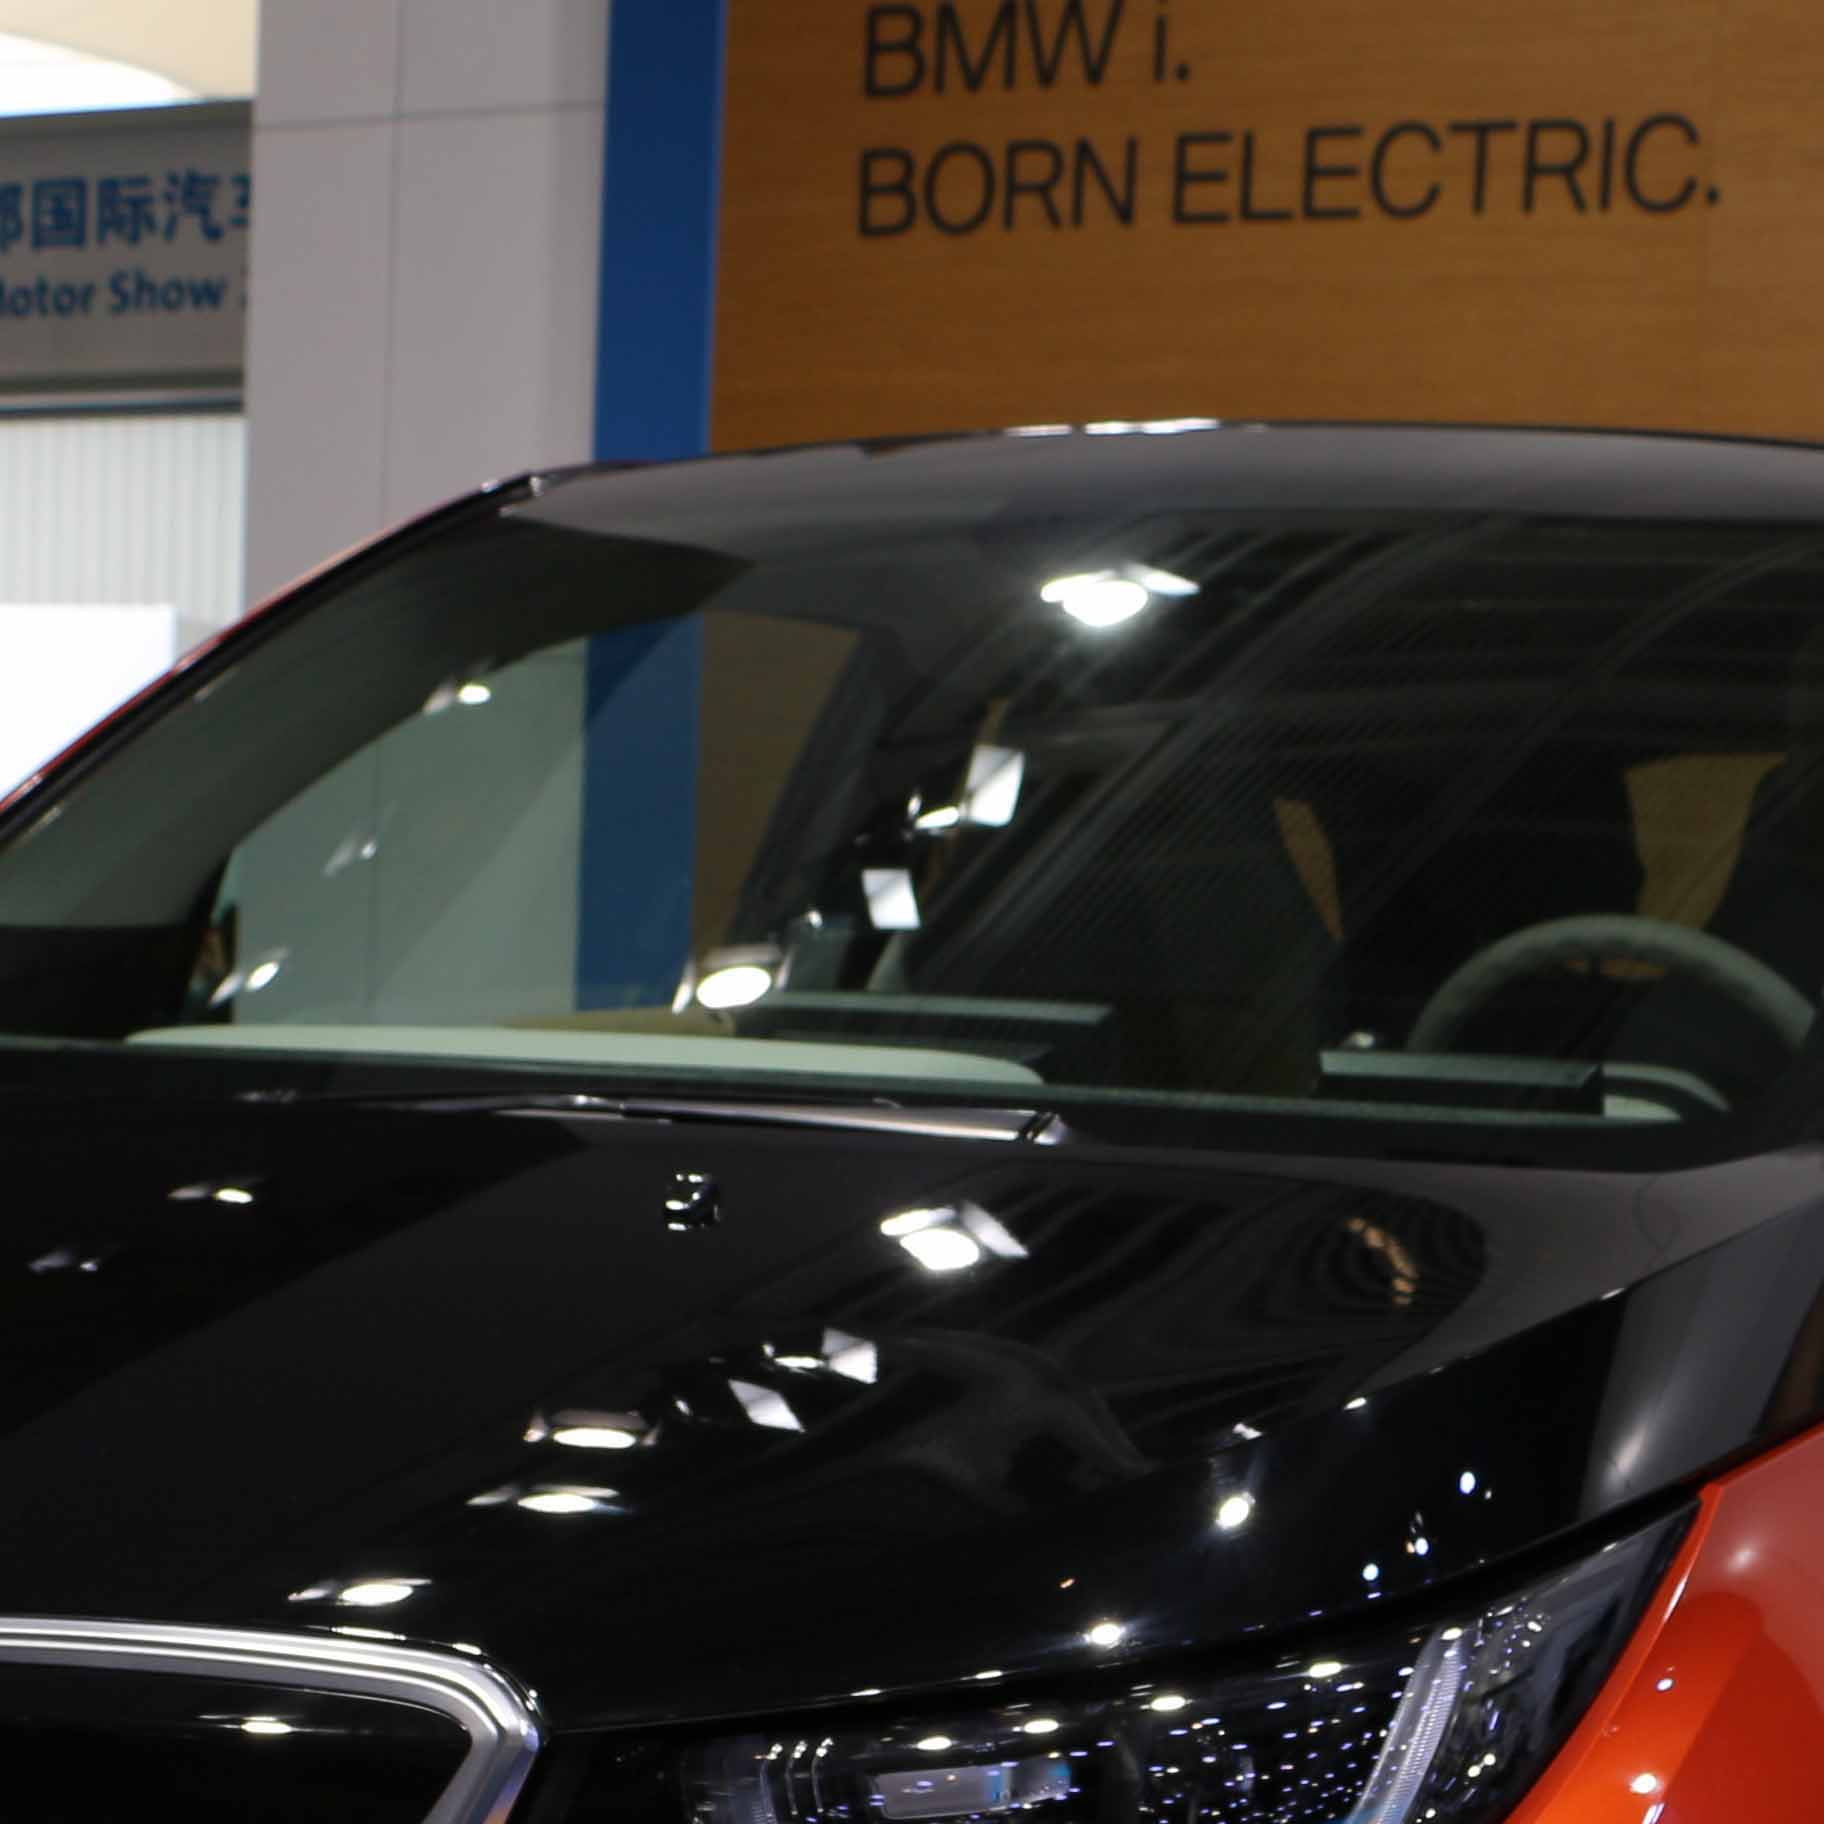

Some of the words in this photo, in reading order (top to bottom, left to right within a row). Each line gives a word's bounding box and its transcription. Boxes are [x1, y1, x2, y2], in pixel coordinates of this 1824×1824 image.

[860, 0, 1125, 101] BMW
[856, 135, 1140, 240] BORN
[1170, 112, 1721, 228] ELECTRIC.
[108, 268, 227, 316] Show
